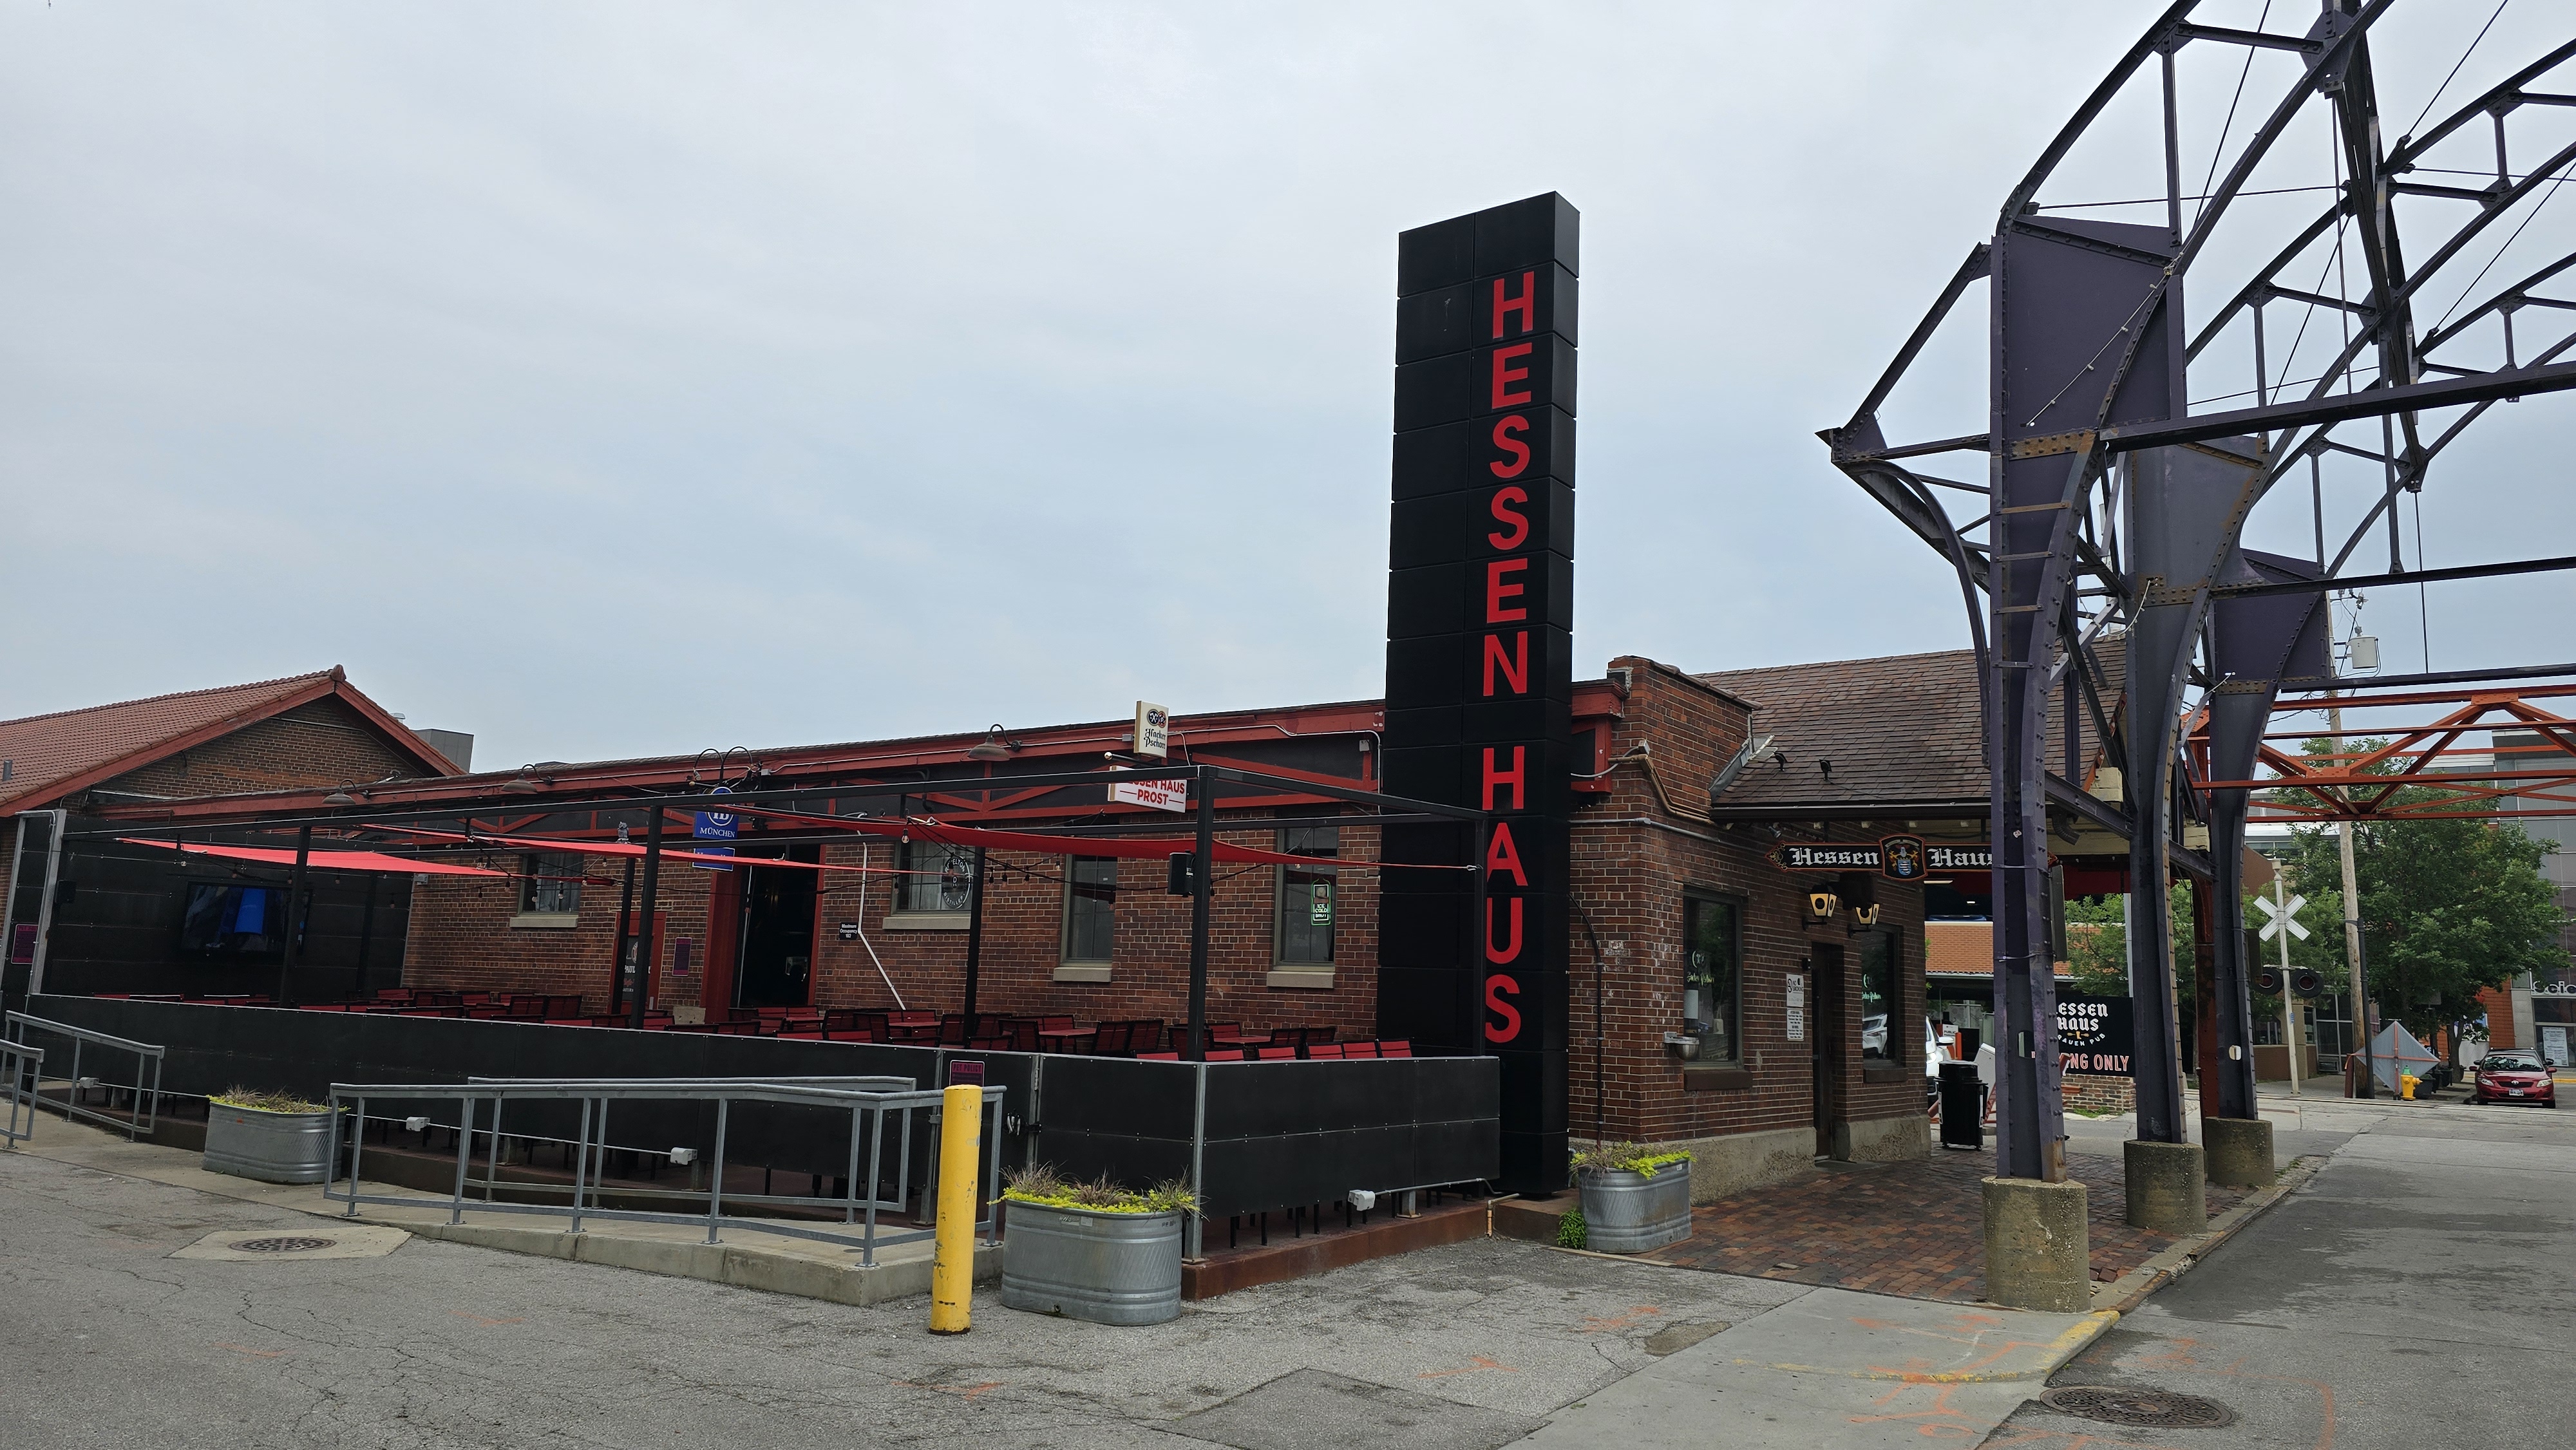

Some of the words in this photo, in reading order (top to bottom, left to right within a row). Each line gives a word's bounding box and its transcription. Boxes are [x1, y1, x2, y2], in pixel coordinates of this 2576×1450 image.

[1483, 271, 1534, 697] HESSEN
[1160, 780, 1185, 795] HAUS
[1137, 789, 1169, 805] PROST
[700, 827, 735, 838] MÜNCHEN
[1789, 848, 1880, 866] Hessen
[1482, 746, 1528, 1043] HAUS
[2089, 1033, 2106, 1045] PUB
[953, 1063, 962, 1071] PET
[964, 1063, 982, 1073] POLICY
[2094, 1054, 2130, 1072] ONLY
